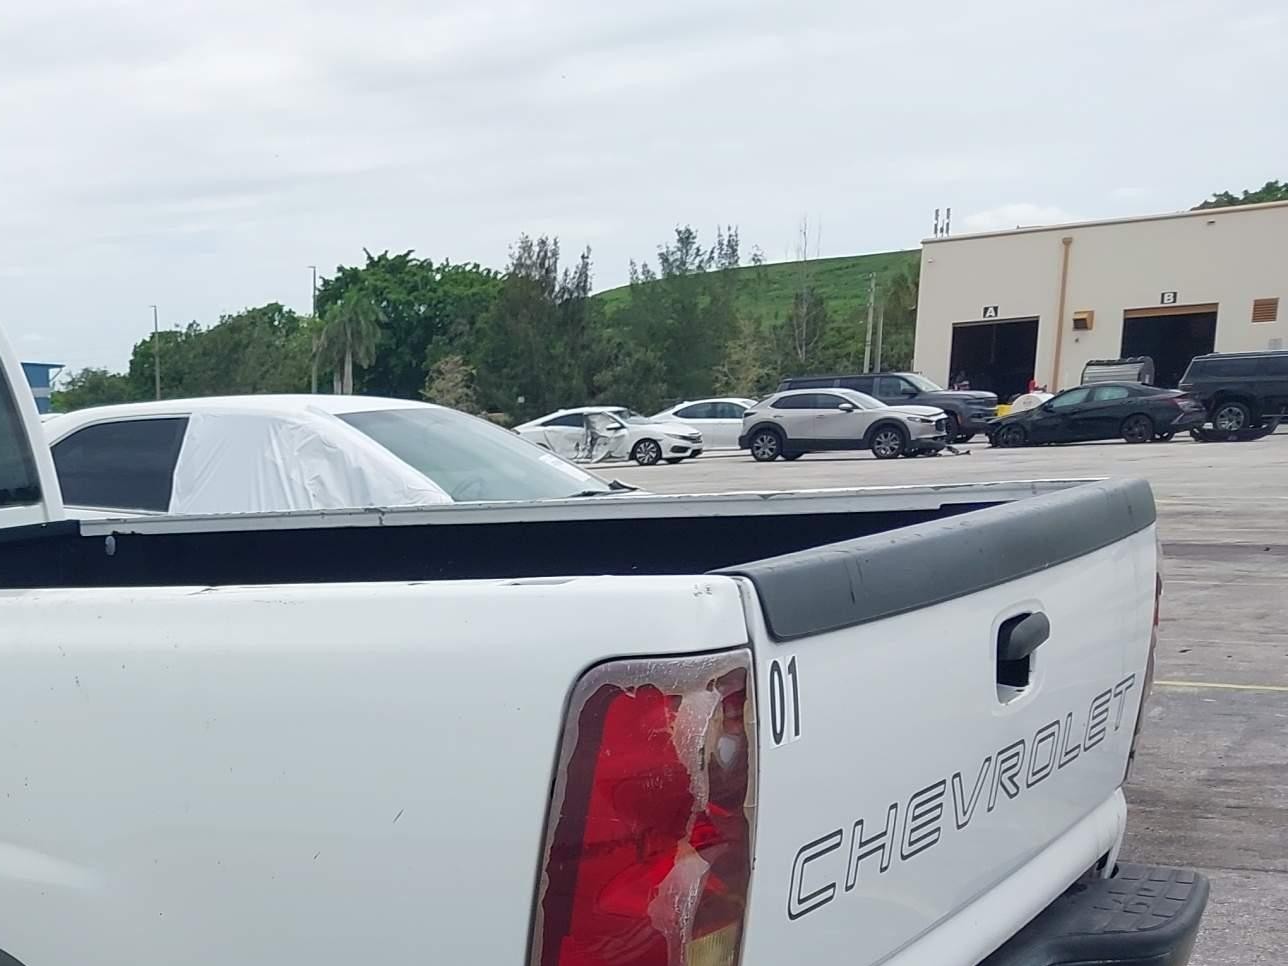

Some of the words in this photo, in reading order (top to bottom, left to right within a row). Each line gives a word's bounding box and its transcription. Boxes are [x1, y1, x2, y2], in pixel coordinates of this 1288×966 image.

[985, 307, 996, 318] A
[1163, 293, 1174, 304] B
[769, 655, 800, 744] 01
[788, 674, 1136, 922] CHEVROLET
